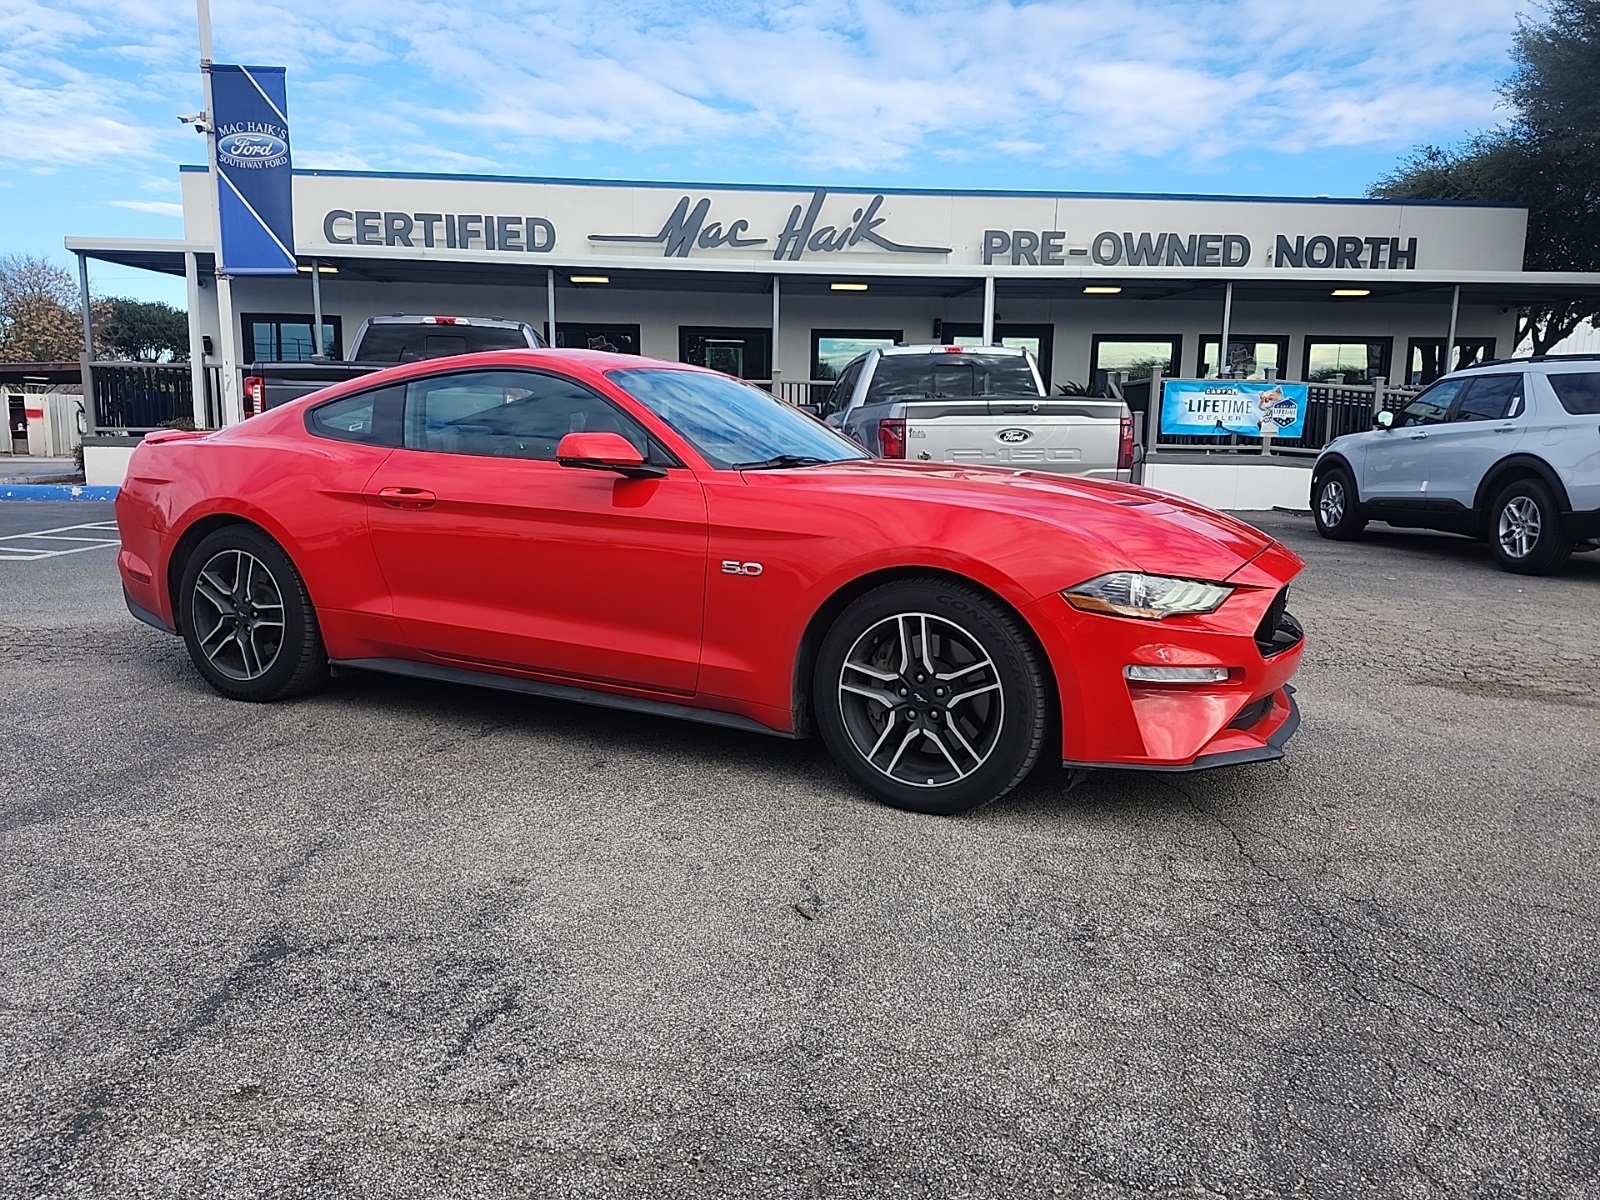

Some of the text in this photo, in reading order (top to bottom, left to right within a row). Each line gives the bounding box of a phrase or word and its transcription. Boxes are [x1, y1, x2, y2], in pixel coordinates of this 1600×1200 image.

[218, 121, 287, 139] MAC HAIK'S
[231, 136, 273, 156] Ford
[219, 154, 288, 169] SOUTHWAY FORD
[323, 209, 557, 253] CERTIFIED
[588, 187, 953, 261] Mac Haik
[983, 229, 1418, 270] PRE-OWNED NORTH
[1188, 399, 1253, 414] LIFETIME
[1003, 432, 1024, 441] Ford
[944, 448, 1082, 462] F-150
[721, 560, 763, 576] 5.0
